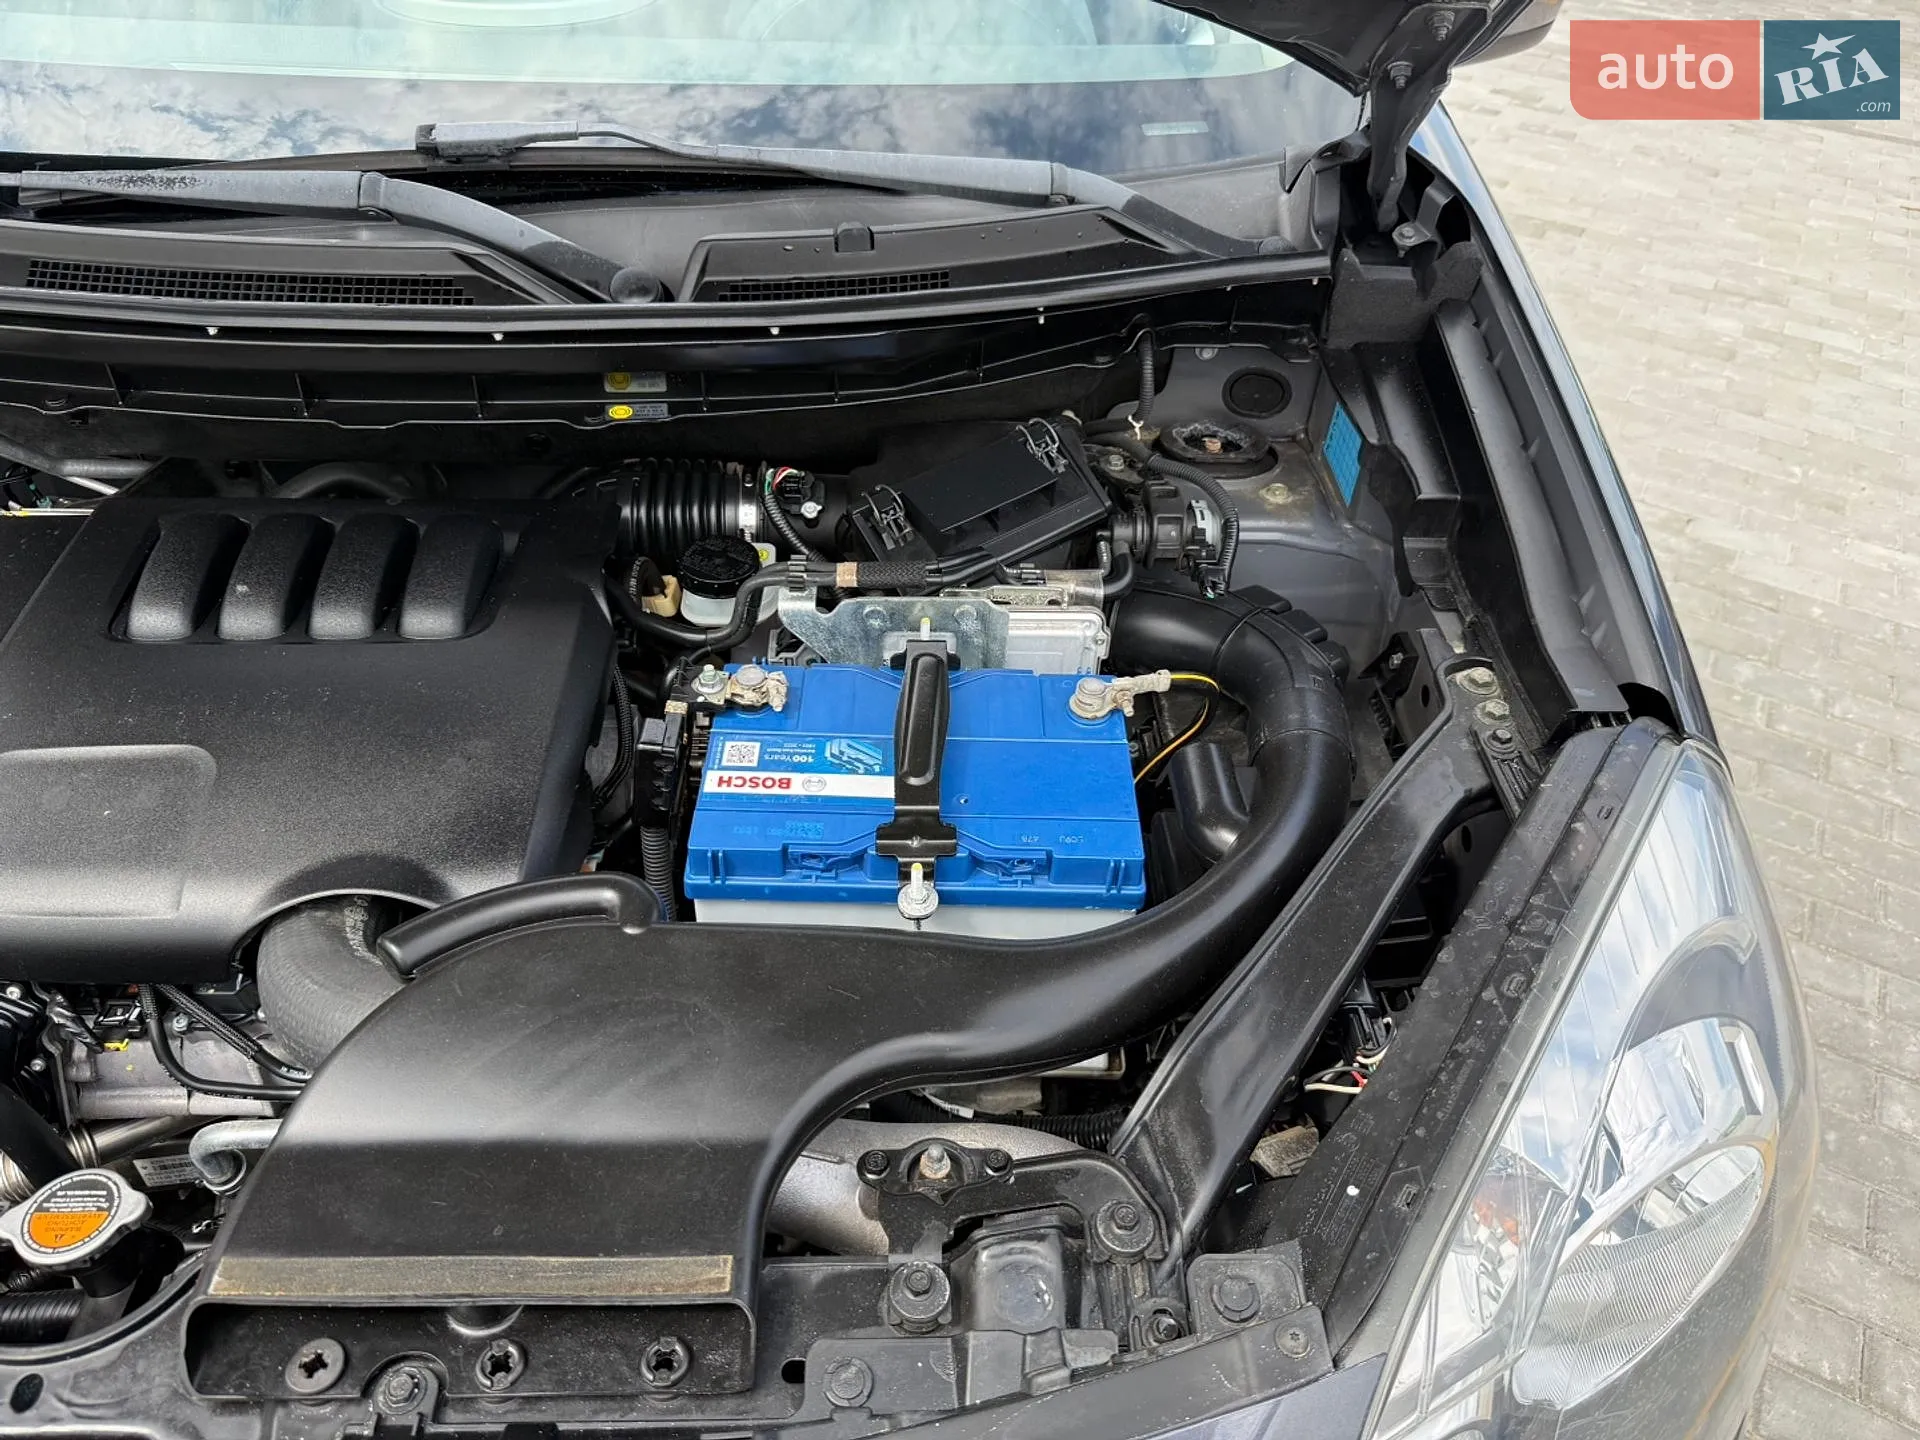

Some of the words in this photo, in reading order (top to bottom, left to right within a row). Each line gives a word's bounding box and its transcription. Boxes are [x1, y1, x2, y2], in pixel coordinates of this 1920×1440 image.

[764, 752, 793, 762] Years
[791, 754, 815, 763] 100
[717, 775, 792, 790] BOSCH
